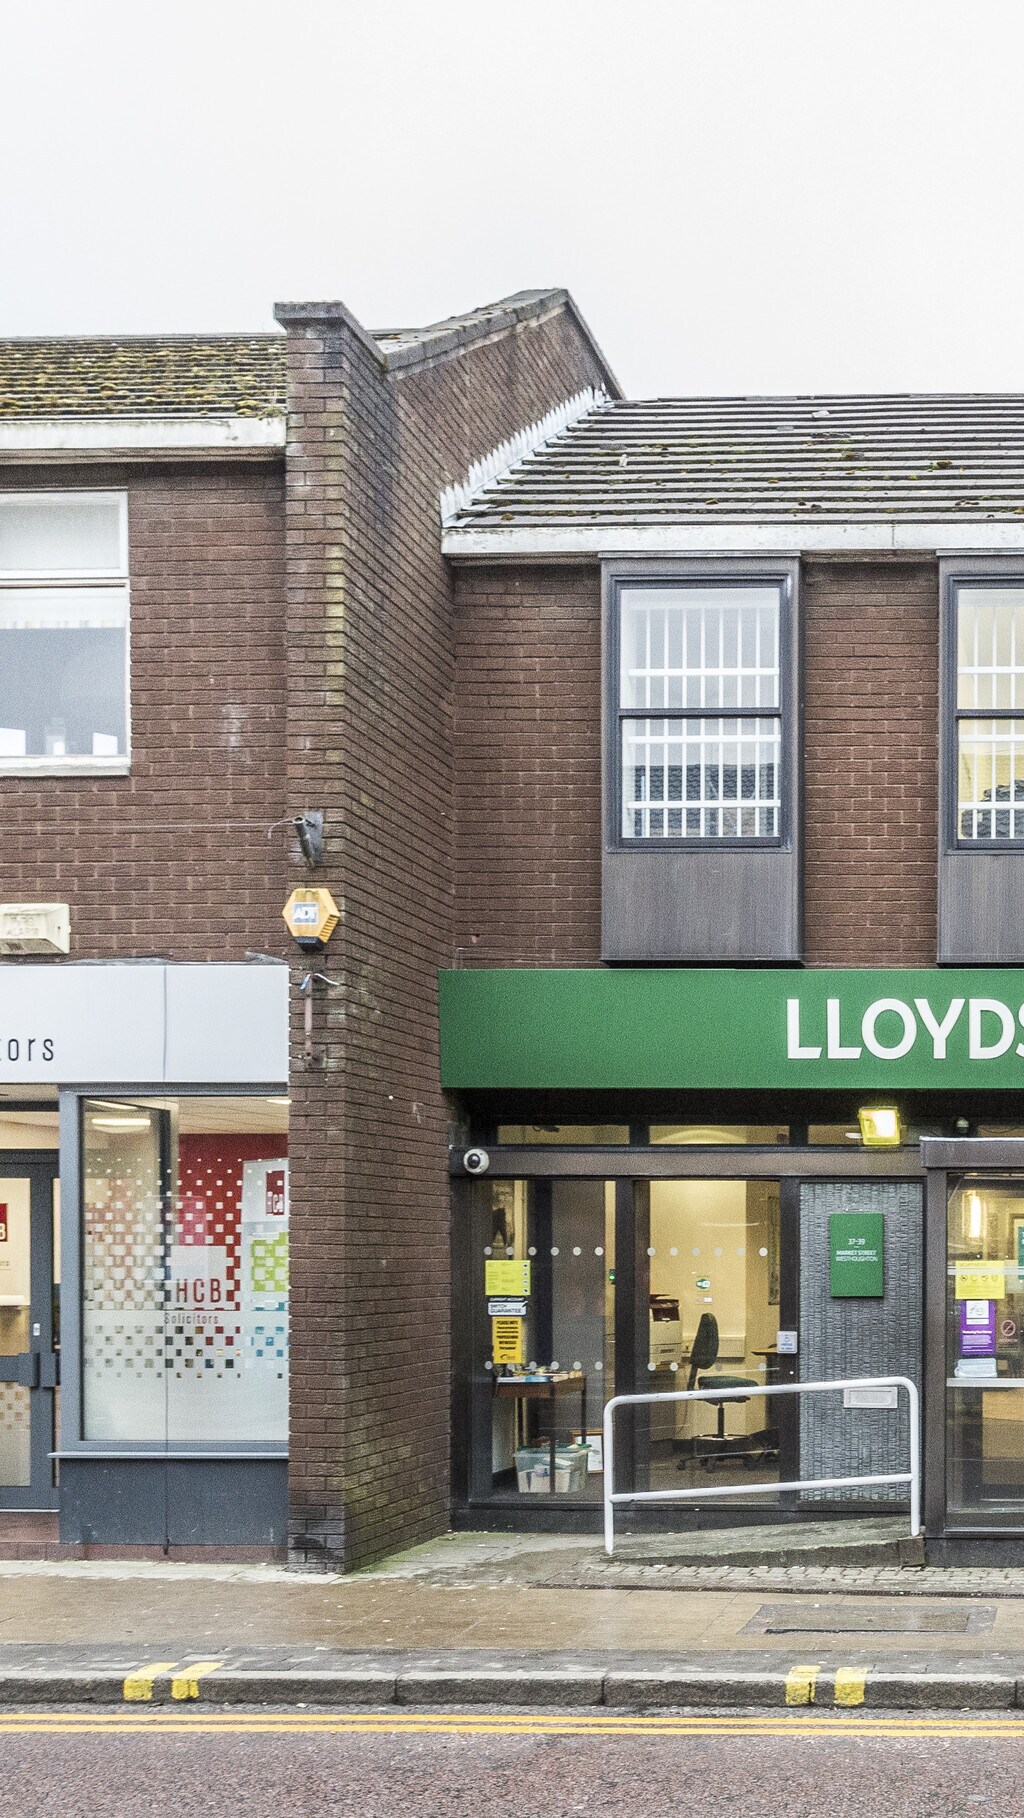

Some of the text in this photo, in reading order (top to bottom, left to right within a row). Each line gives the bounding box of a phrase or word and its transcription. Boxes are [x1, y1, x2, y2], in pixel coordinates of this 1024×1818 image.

[293, 906, 317, 920] ADT
[0, 1038, 54, 1061] ors
[176, 1278, 221, 1303] HCB
[164, 1313, 219, 1325] Solicitors
